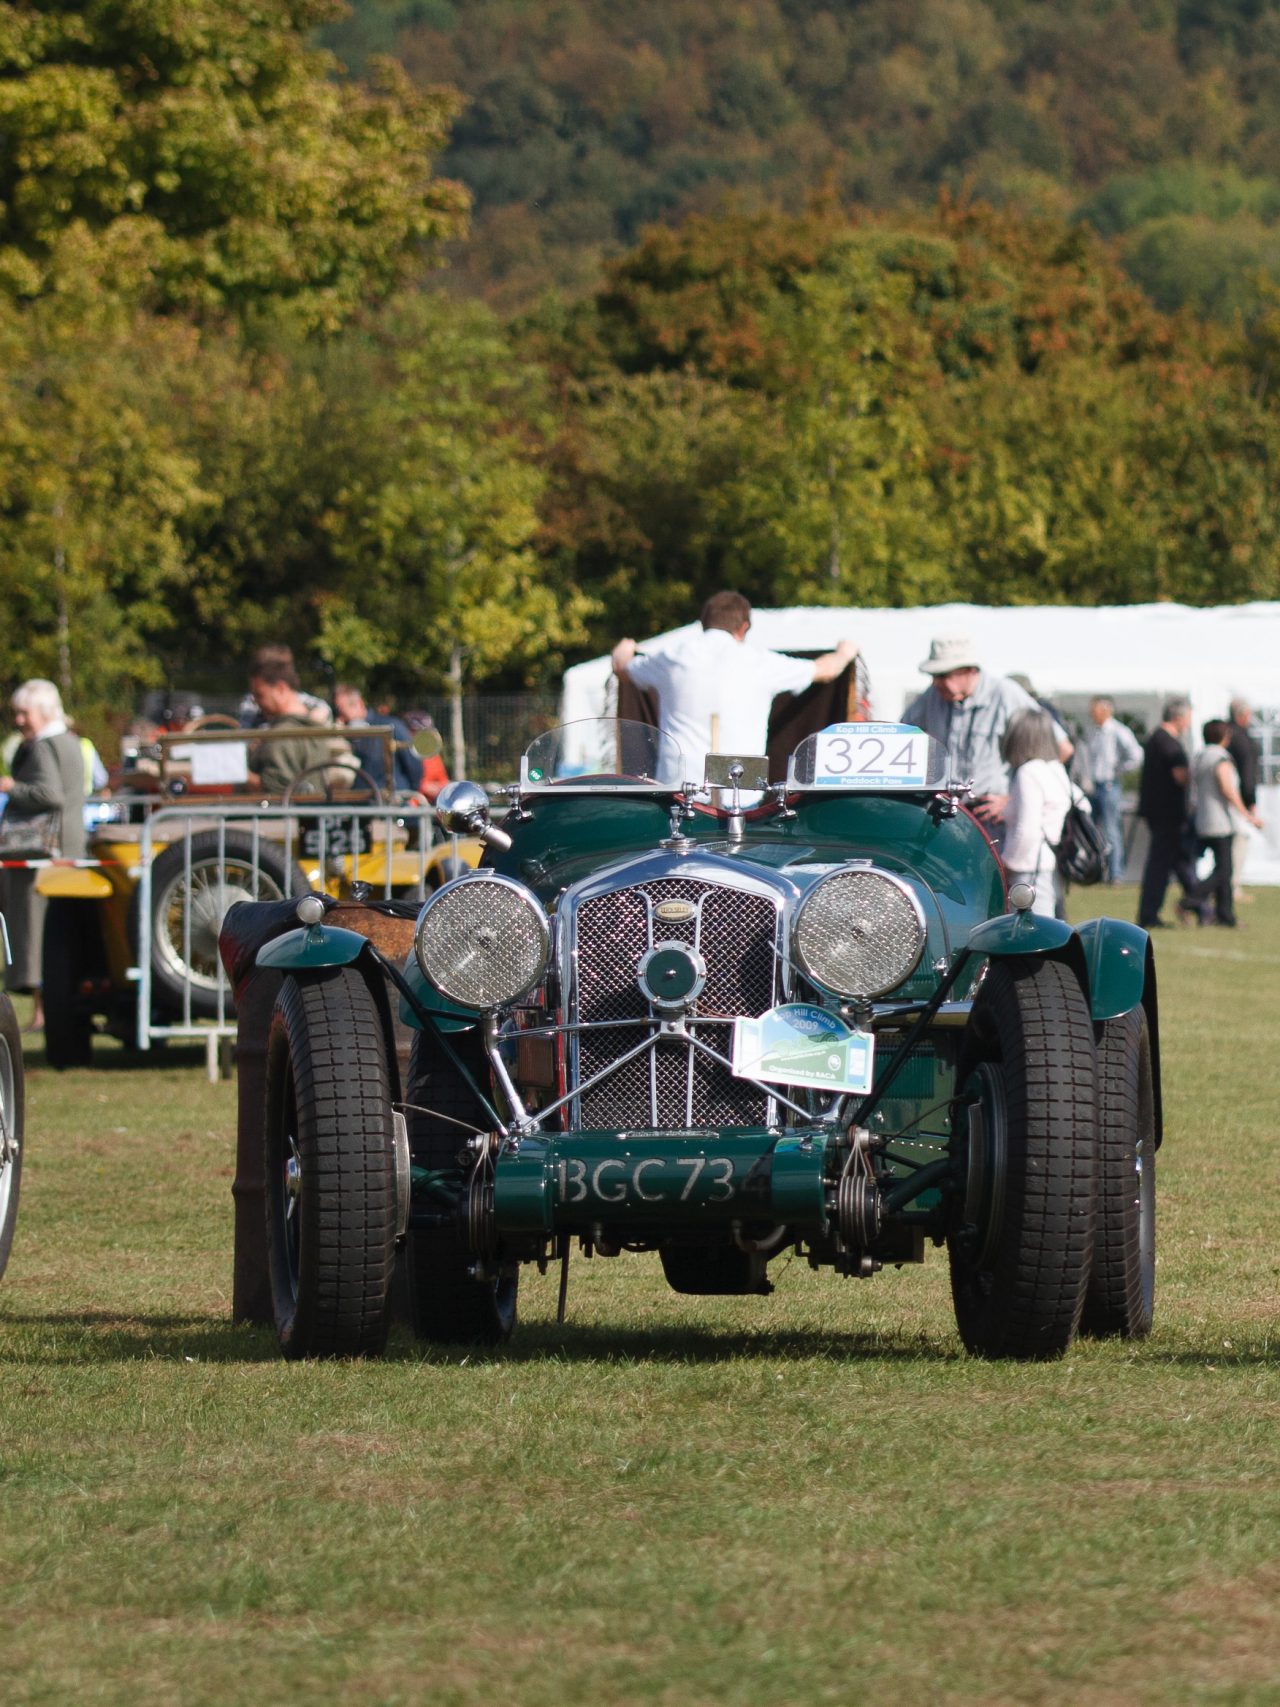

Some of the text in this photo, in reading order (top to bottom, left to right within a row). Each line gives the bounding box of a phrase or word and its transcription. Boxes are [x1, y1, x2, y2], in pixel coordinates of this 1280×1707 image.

[836, 726, 854, 734] Kop
[825, 738, 917, 774] 324
[841, 777, 881, 785] Paddock
[793, 1019, 819, 1030] 2009
[794, 1008, 808, 1017] Hill
[810, 1011, 836, 1029] Climb
[558, 1157, 666, 1202] BGC
